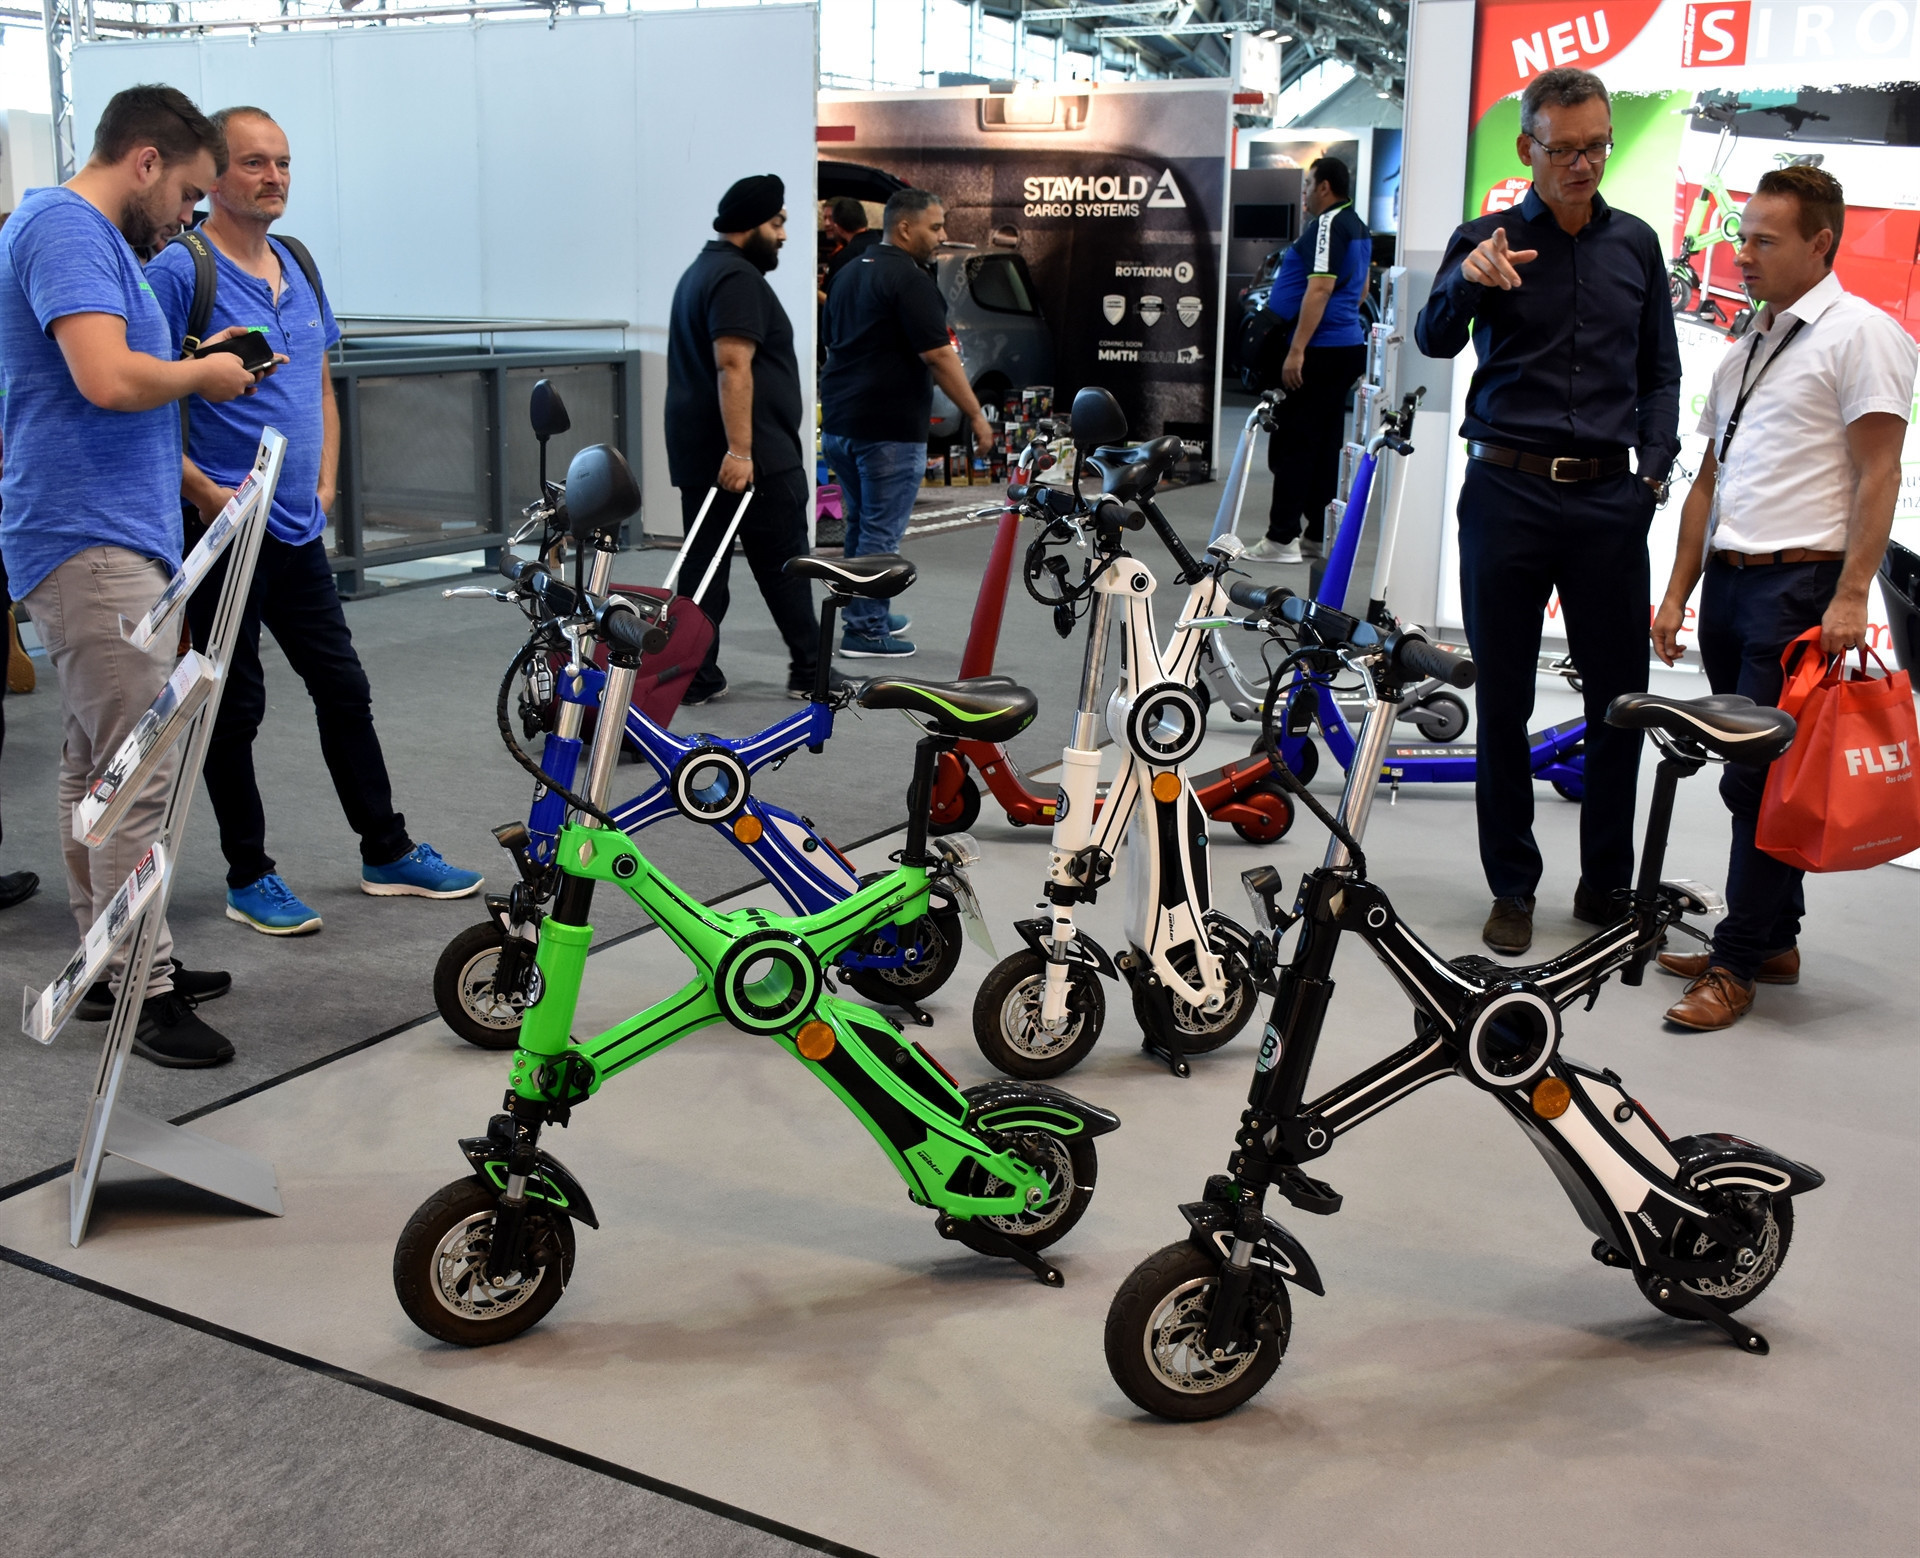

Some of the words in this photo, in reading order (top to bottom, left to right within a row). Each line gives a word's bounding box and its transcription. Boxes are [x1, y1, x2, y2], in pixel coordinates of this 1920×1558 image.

[1511, 10, 1610, 78] NEU
[1023, 175, 1149, 201] STAYHOLD
[1023, 203, 1072, 217] CARGO
[1075, 203, 1140, 217] SYSTEMS
[1115, 266, 1172, 278] ROTATION
[1098, 340, 1125, 348] COMING
[1125, 340, 1143, 348] SOON
[1396, 748, 1448, 756] SIRO
[1844, 739, 1911, 777] FLEX
[1259, 1033, 1278, 1059] B
